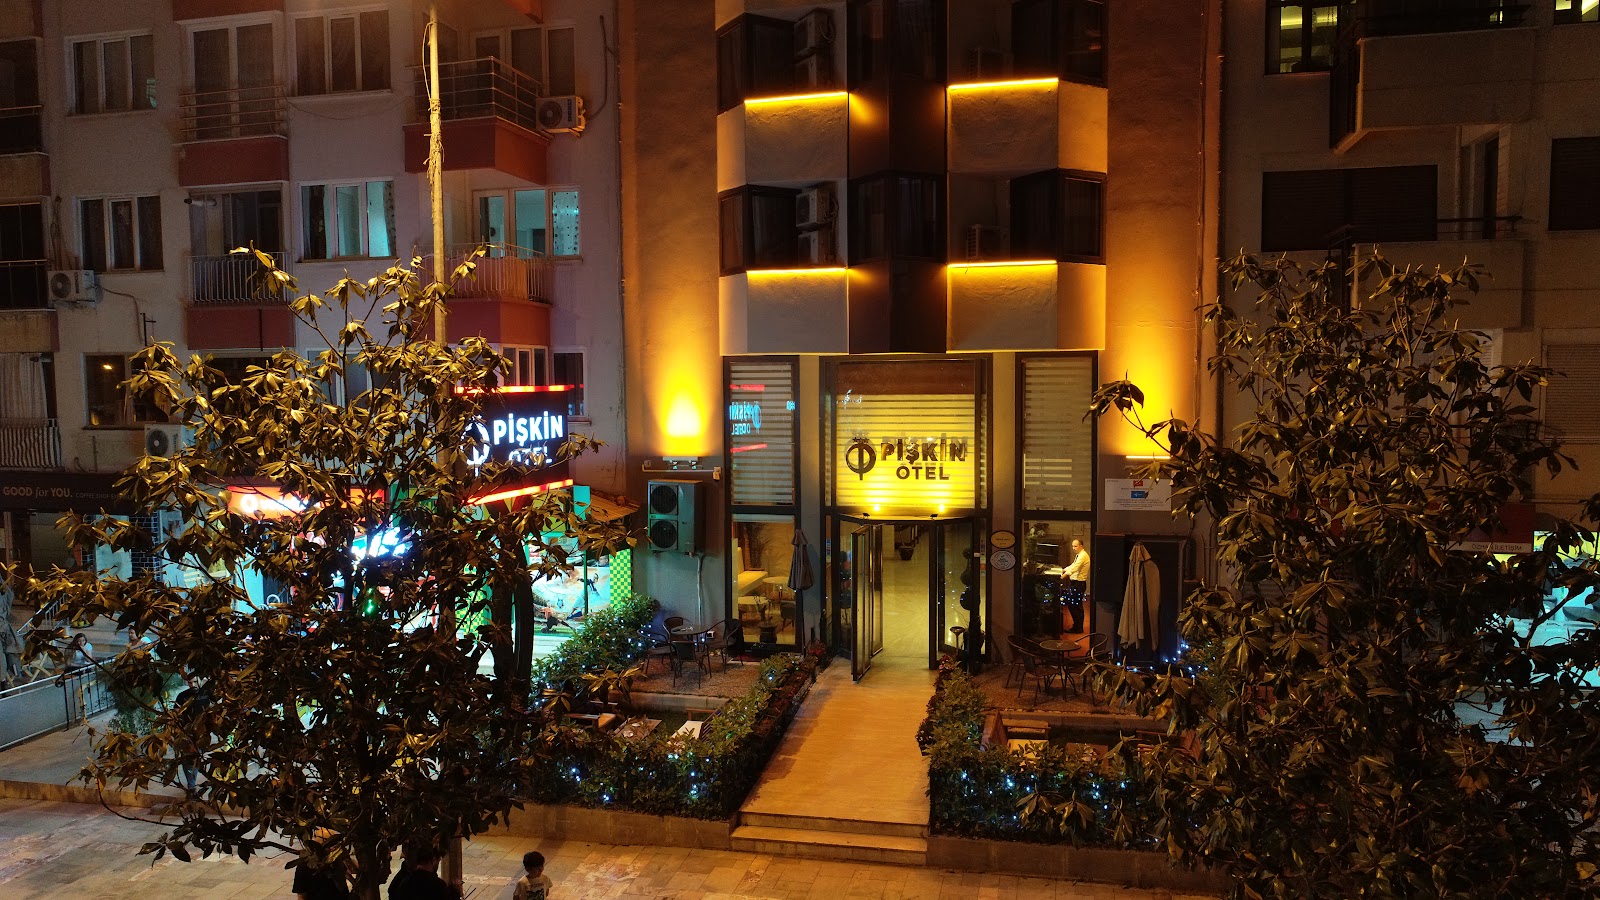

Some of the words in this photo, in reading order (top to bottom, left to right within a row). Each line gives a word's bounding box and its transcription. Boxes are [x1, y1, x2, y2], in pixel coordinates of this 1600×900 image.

[493, 411, 563, 447] PİŞKİN
[880, 437, 966, 465] PİŞKİN
[896, 465, 950, 480] OTEL
[2, 486, 33, 496] GOOD
[35, 486, 49, 498] for
[50, 487, 73, 498] YOU.
